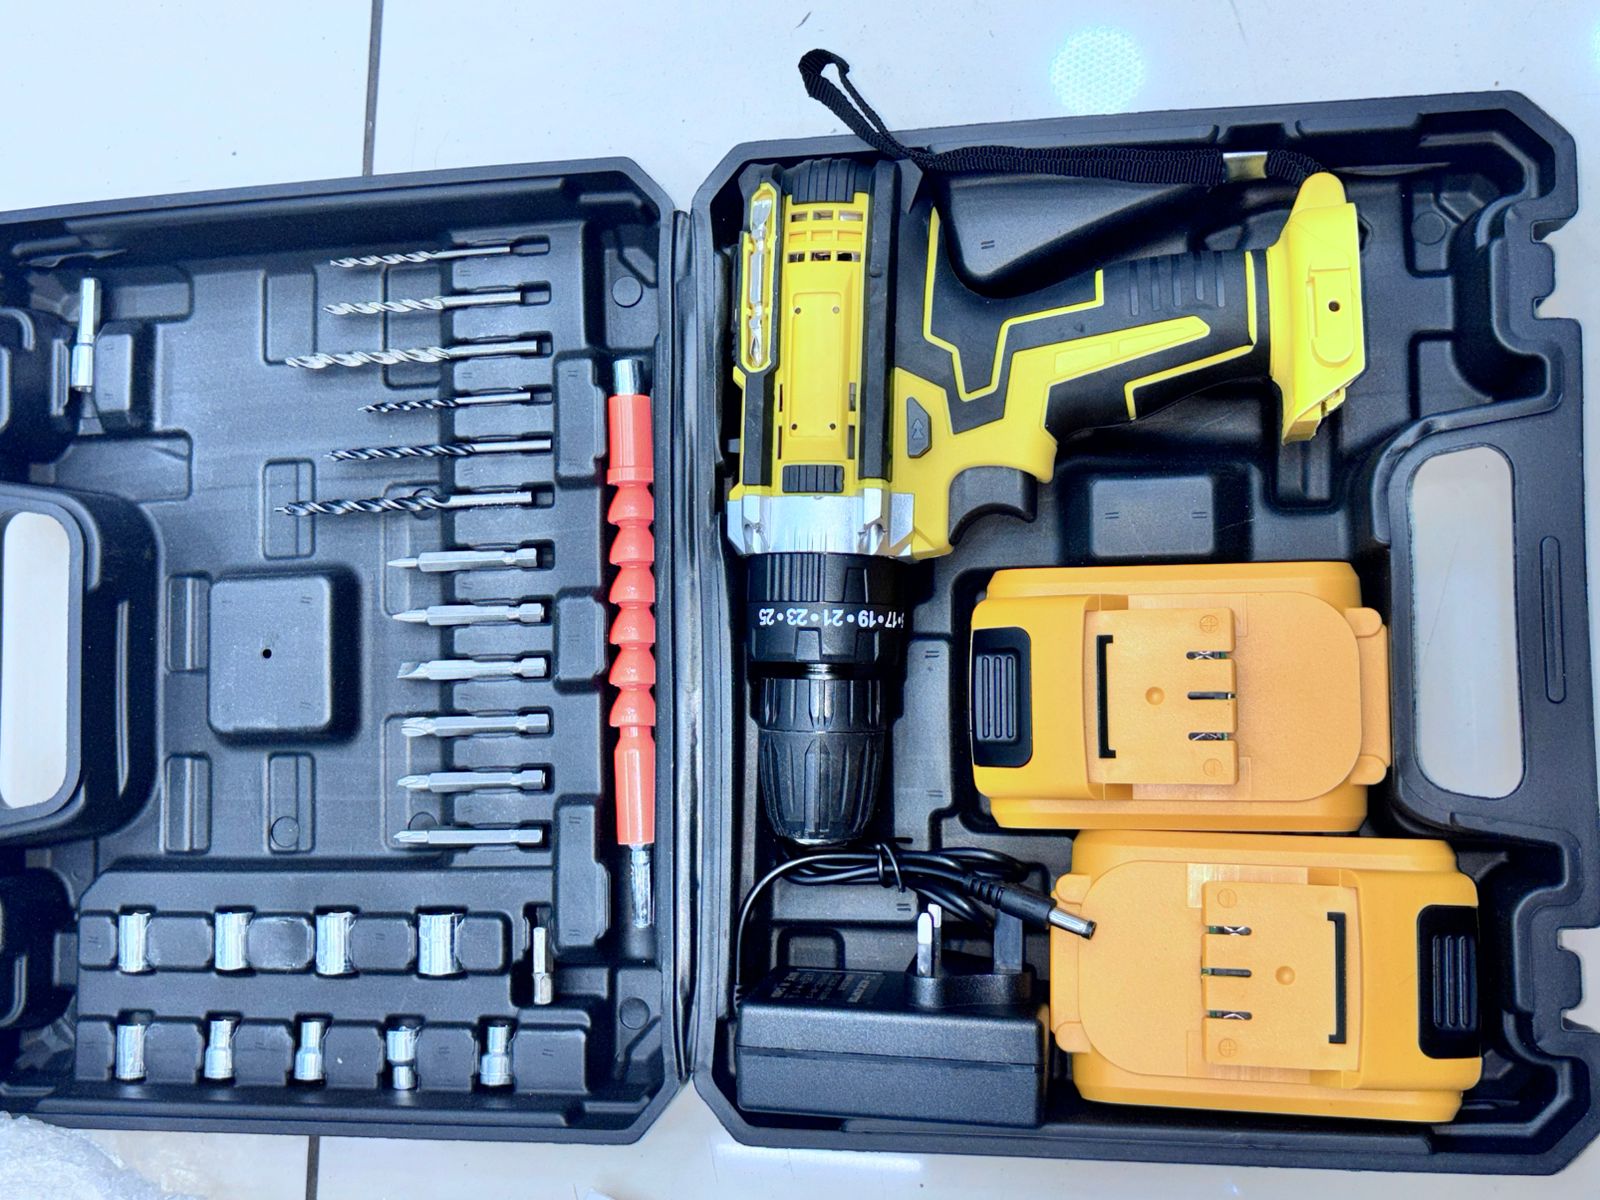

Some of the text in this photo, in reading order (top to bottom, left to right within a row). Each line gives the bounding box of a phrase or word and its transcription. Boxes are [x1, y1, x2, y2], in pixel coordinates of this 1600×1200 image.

[758, 608, 775, 626] 25
[786, 607, 808, 626] 23
[823, 608, 844, 627] 21
[857, 609, 877, 628] 19
[884, 611, 897, 628] 17
